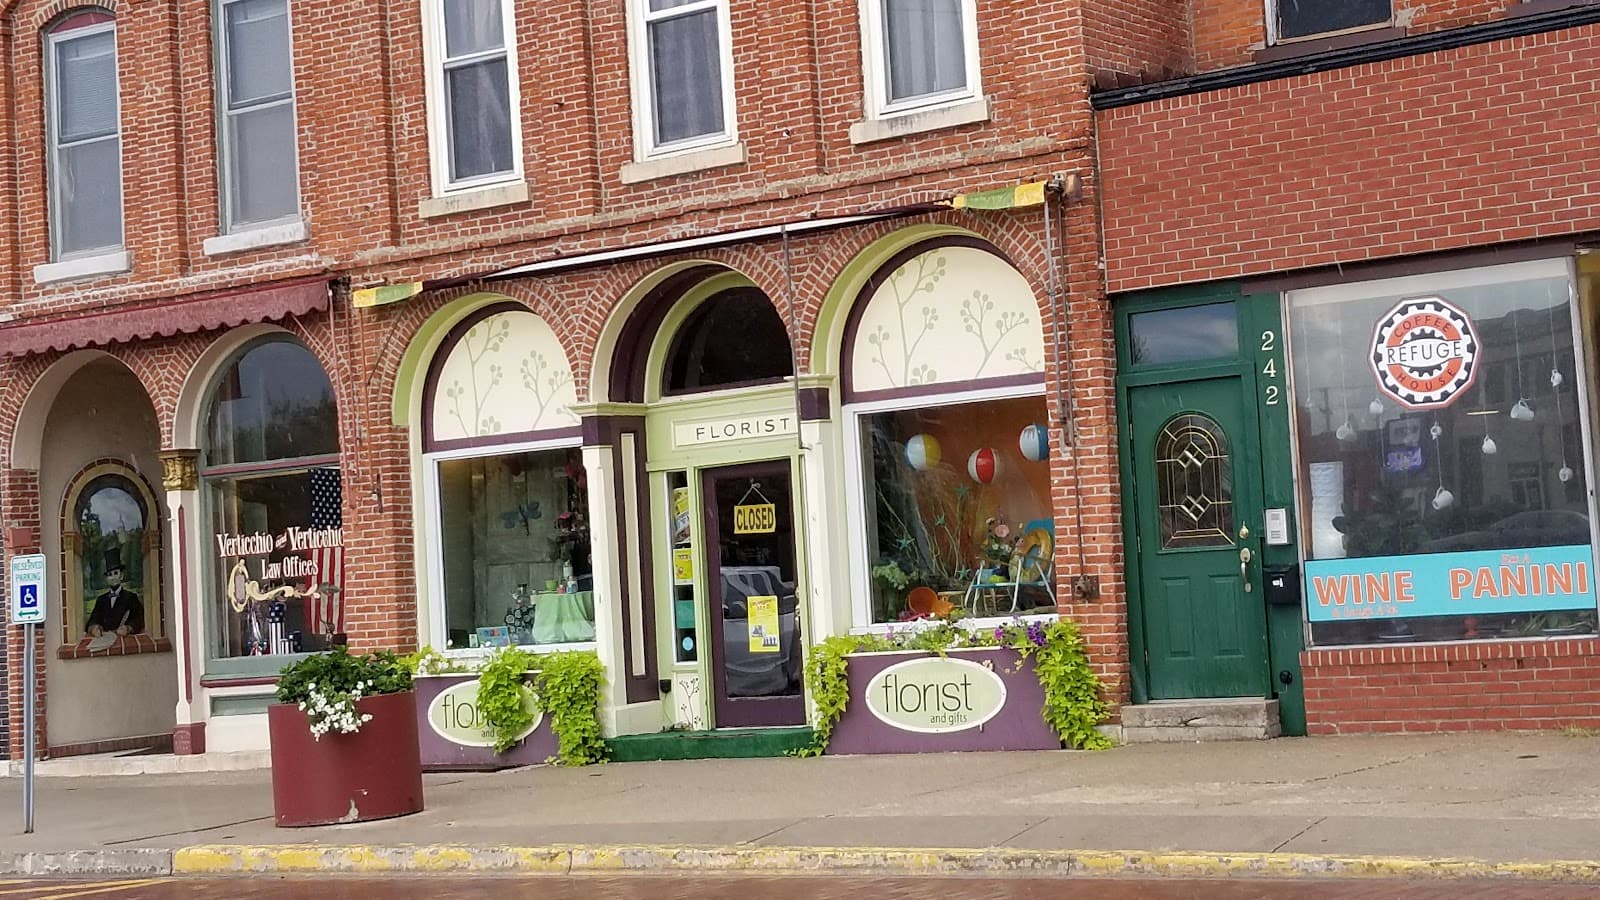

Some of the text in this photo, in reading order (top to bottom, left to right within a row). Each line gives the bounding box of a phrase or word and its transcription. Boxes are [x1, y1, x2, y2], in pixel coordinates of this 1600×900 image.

[1394, 315, 1451, 338] COFFEE
[1387, 341, 1462, 363] REFUGE
[1397, 368, 1455, 390] HOUSE
[696, 418, 789, 440] FLORIST
[736, 507, 774, 531] CLOSED
[216, 531, 274, 557] Verticchio
[275, 532, 288, 549] and
[13, 561, 43, 572] RESERVED
[15, 572, 41, 582] PARKING
[262, 556, 319, 580] Law Offices
[1312, 570, 1415, 606] WINE
[1449, 562, 1588, 600] PANINI
[881, 673, 973, 713] florist
[930, 712, 968, 726] and gifts
[481, 727, 495, 738] and
